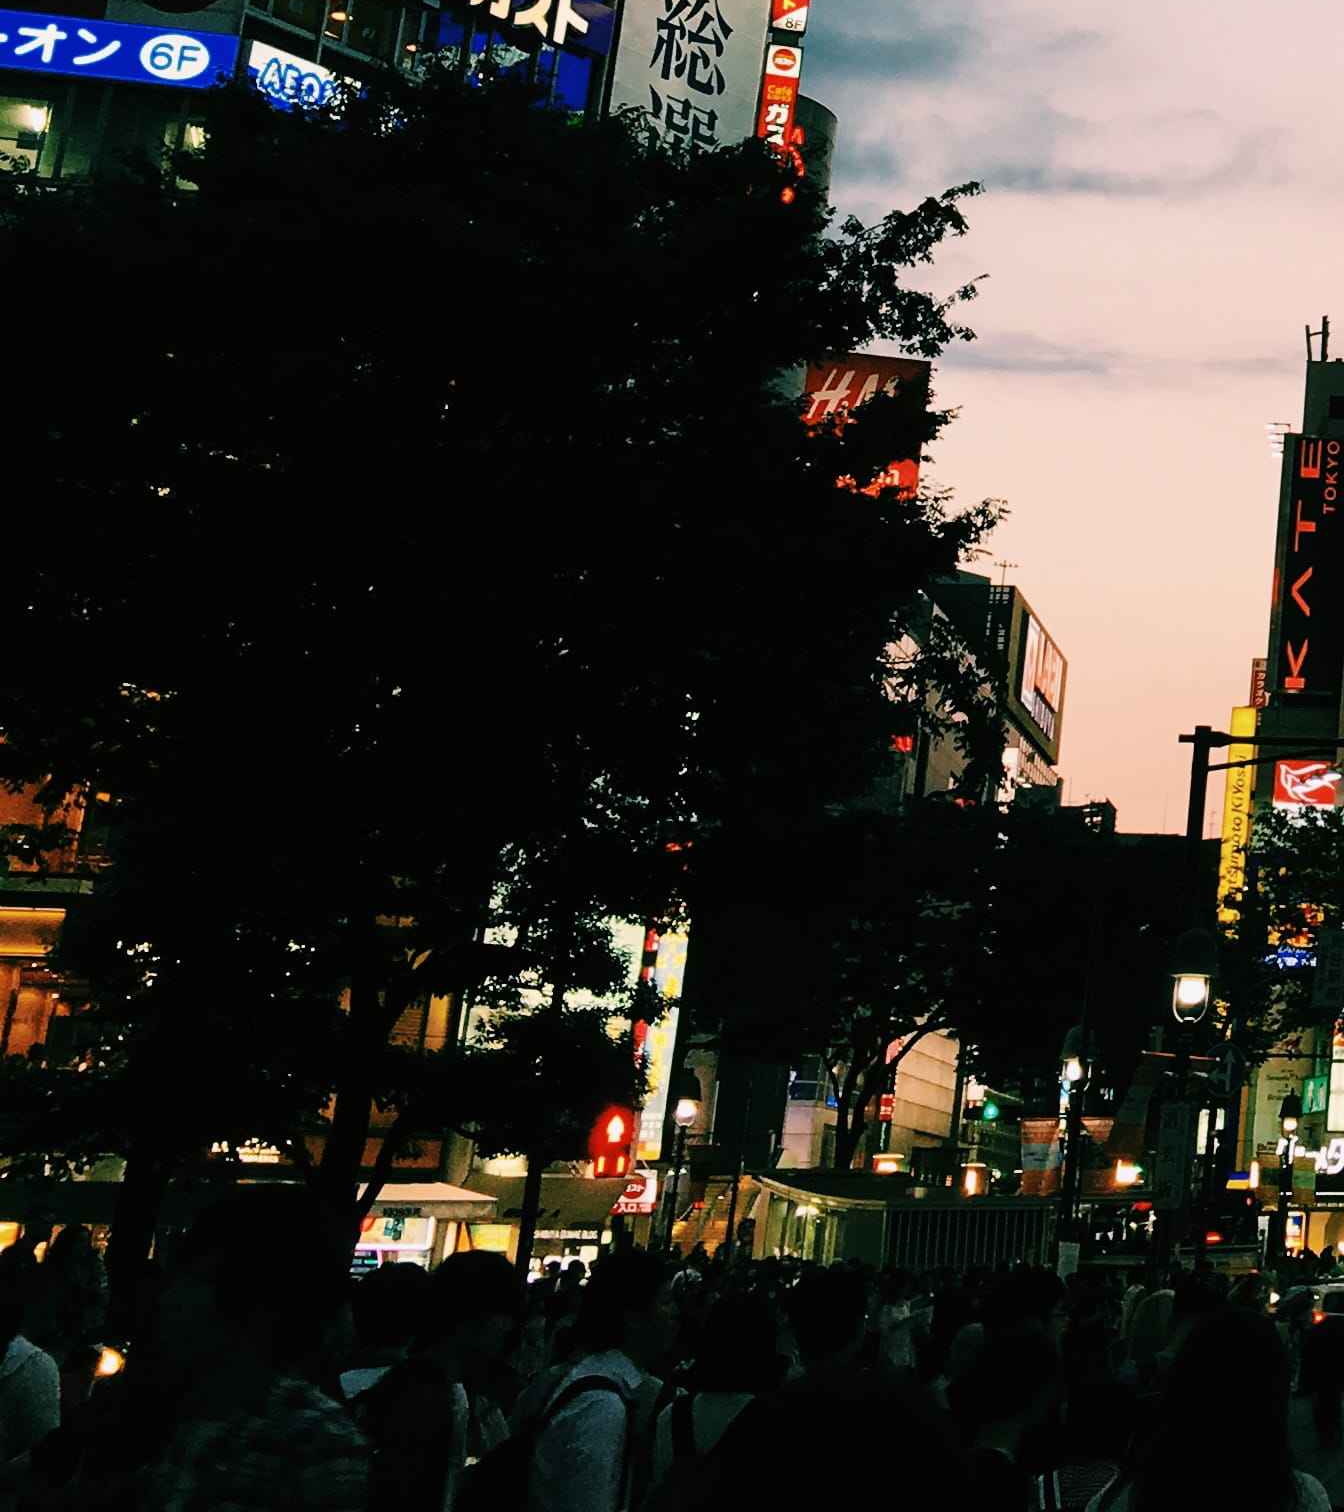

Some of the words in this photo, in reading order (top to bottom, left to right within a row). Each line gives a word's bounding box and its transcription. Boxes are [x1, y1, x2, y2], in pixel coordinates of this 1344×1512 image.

[785, 16, 802, 30] 8F
[0, 21, 122, 68] オン
[148, 42, 203, 73] 6F
[1322, 439, 1342, 515] TOKYO
